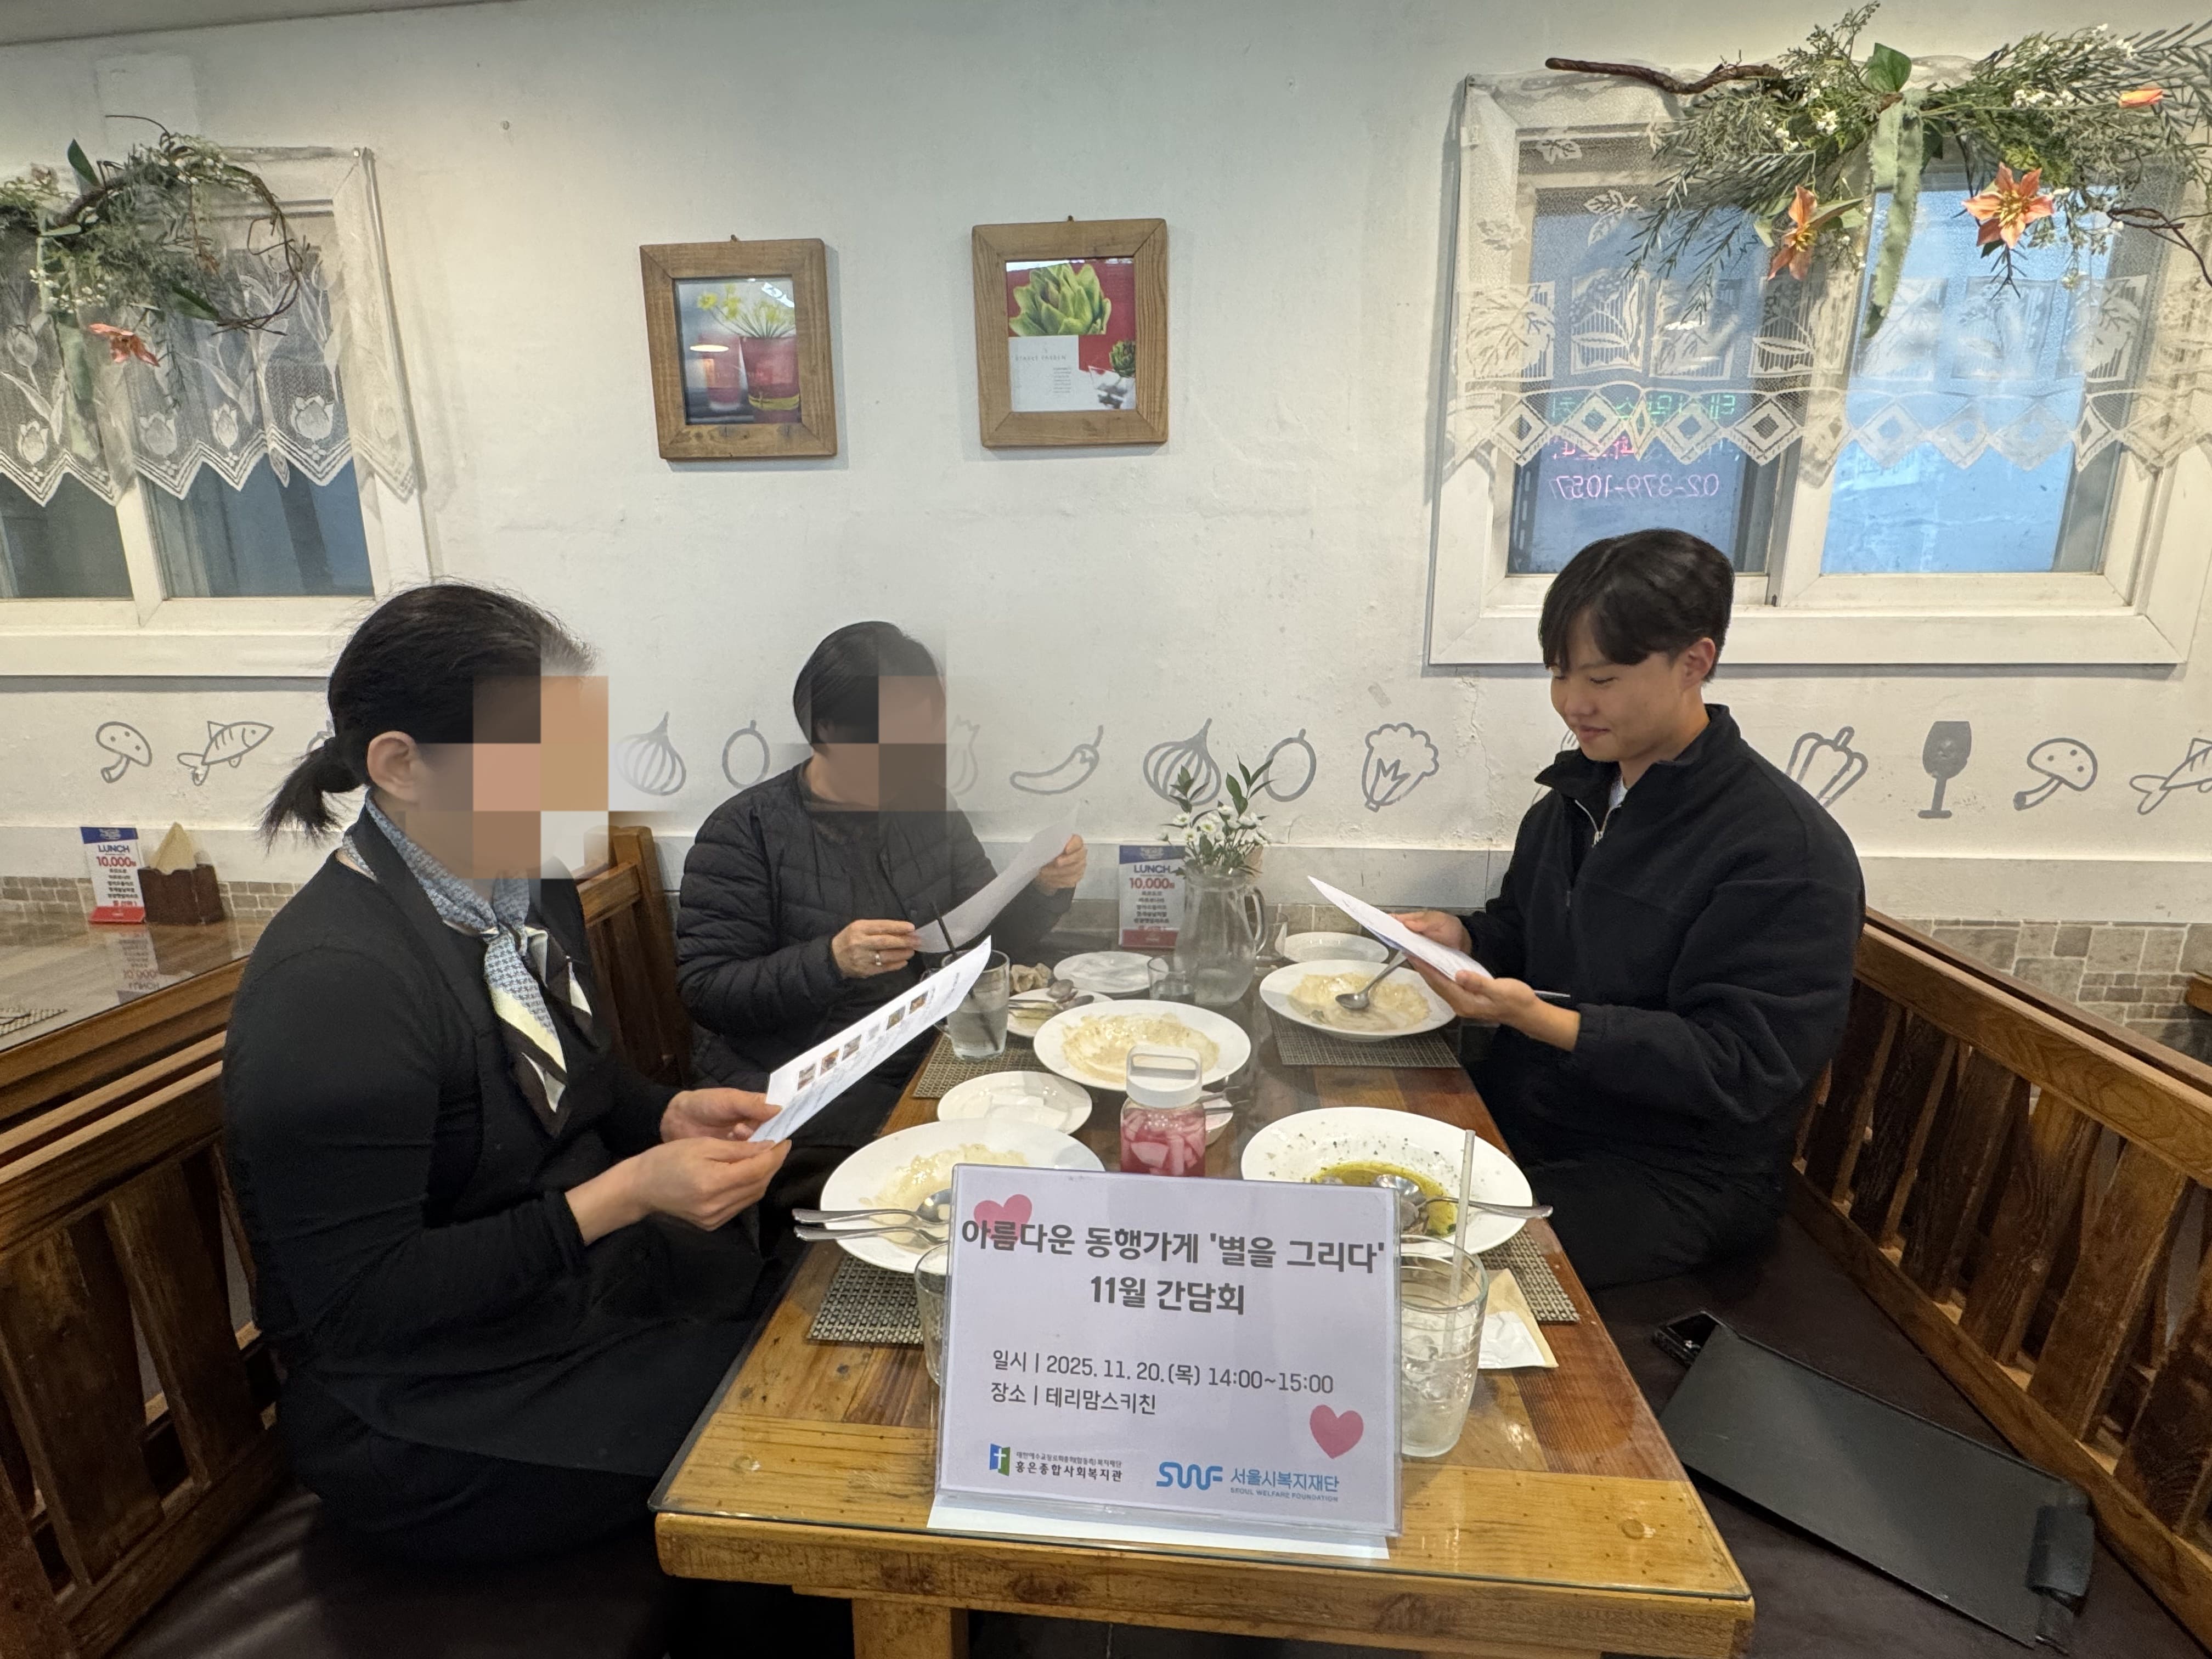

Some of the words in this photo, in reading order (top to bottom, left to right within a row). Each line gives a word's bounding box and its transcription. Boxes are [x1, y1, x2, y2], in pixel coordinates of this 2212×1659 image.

[98, 845, 130, 853] LUNCH
[1133, 865, 1171, 873] LUNCH
[962, 1220, 1075, 1255] 아름다운
[1085, 1227, 1198, 1263] 동행가게
[1210, 1233, 1277, 1268] '별을
[1286, 1240, 1385, 1274] 그리다'
[1091, 1276, 1146, 1308] 11월
[1157, 1280, 1244, 1316] 간담회
[993, 1350, 1026, 1372] 일시
[1047, 1355, 1097, 1378] 2025.
[1104, 1359, 1130, 1380] 11.
[1209, 1367, 1334, 1394] 14:00~15:00
[991, 1383, 1026, 1403] 장소
[1046, 1387, 1155, 1415] 테리맘스키친
[1015, 1461, 1123, 1482] 홍은종합사회복지관
[1156, 1462, 1223, 1491] SWF
[1230, 1467, 1340, 1493] 서울시복지재단
[1230, 1487, 1255, 1496] SEOUL
[1256, 1490, 1290, 1499] WELFARE
[1291, 1493, 1339, 1502] FOUNDATION
